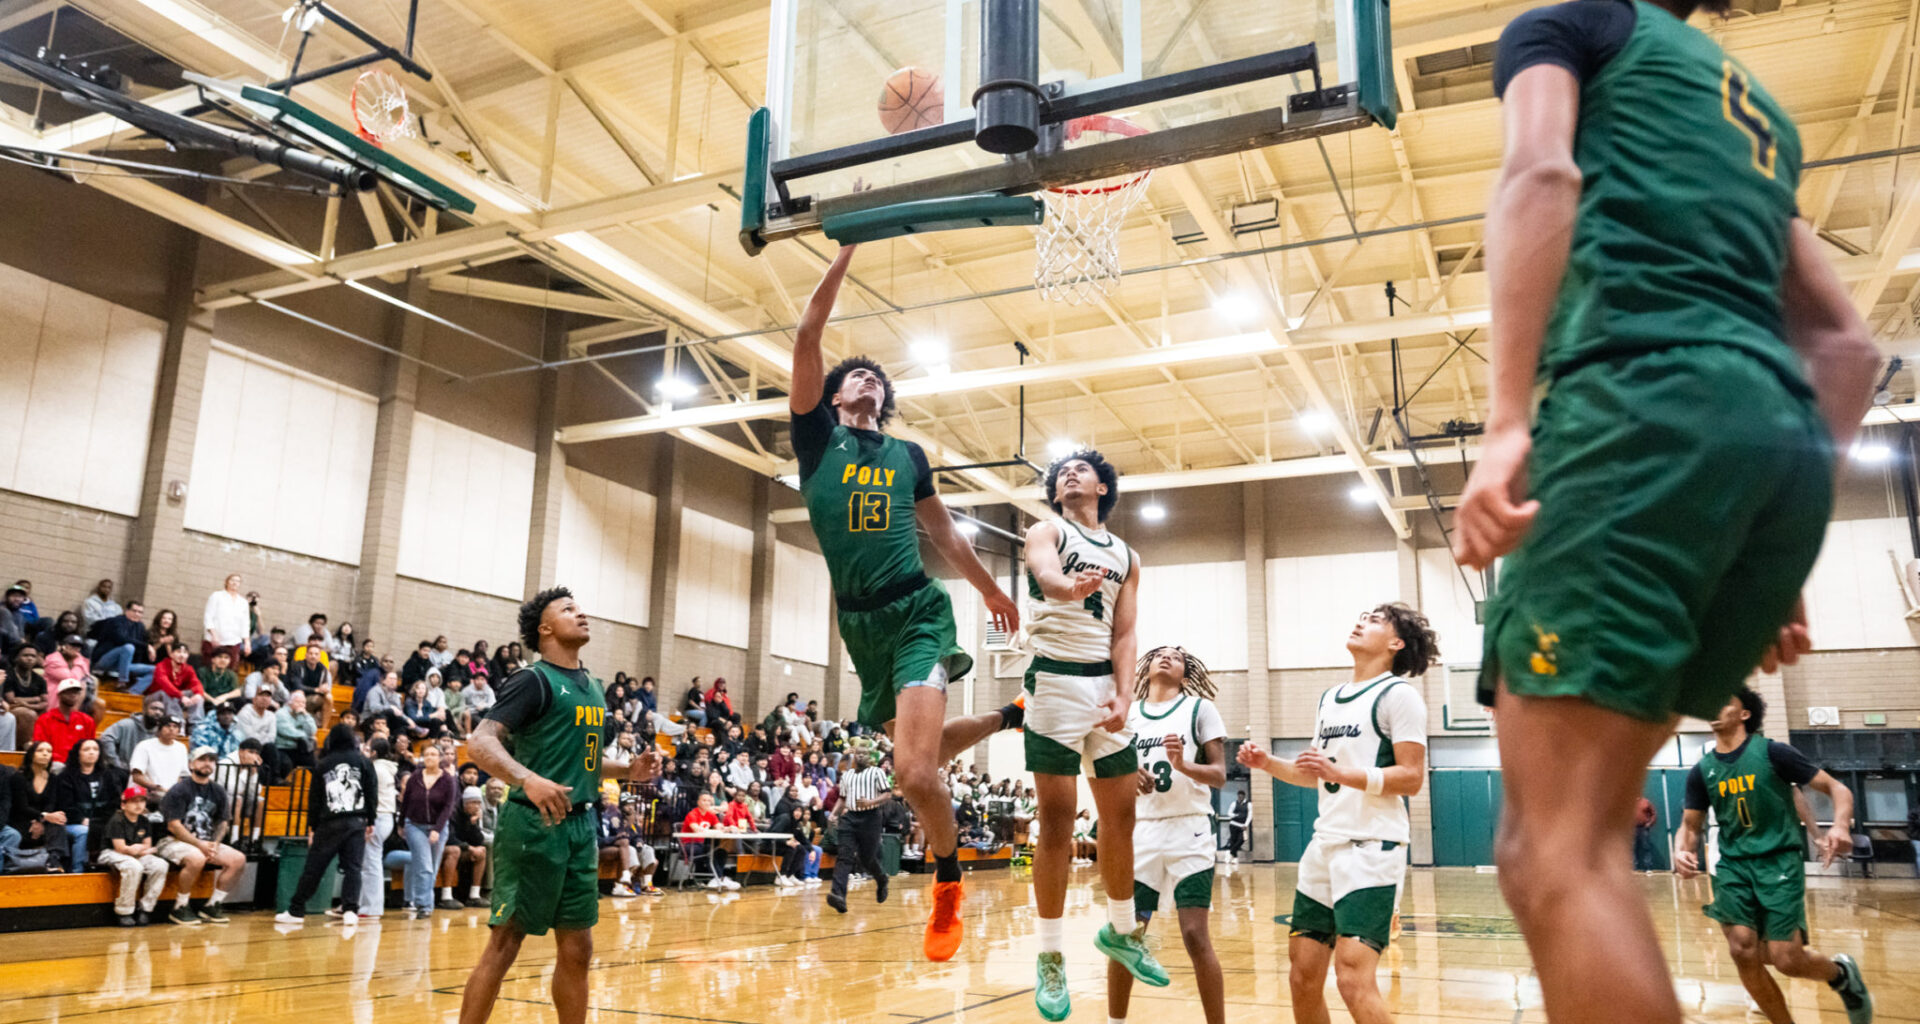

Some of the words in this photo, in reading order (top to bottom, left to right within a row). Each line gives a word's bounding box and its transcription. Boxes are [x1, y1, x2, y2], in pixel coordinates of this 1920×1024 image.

[842, 464, 896, 487] POLY
[848, 491, 891, 532] 13
[575, 705, 605, 727] POLY
[584, 732, 599, 772] 3
[1143, 761, 1173, 793] 3
[1718, 774, 1756, 798] POLY
[1737, 797, 1753, 828] 1
